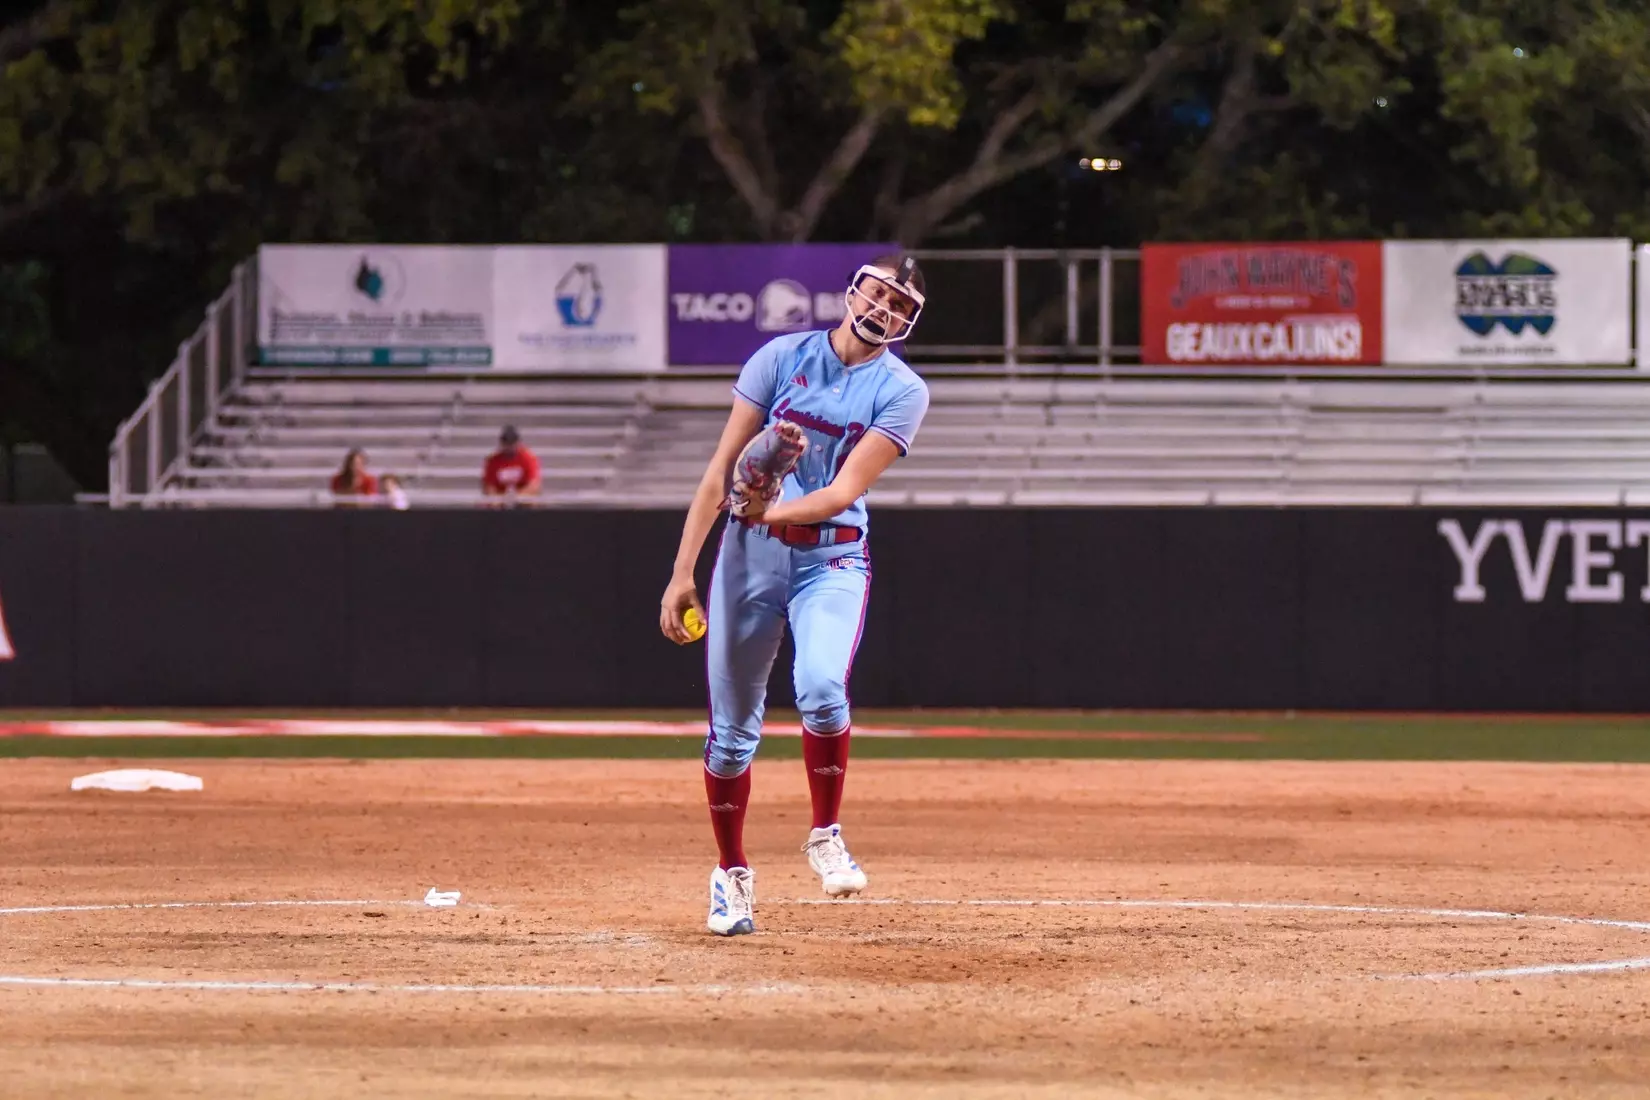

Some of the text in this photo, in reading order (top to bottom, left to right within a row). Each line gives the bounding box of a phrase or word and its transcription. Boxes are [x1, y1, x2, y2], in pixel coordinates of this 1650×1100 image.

[673, 291, 846, 321] TACO BE
[1166, 321, 1255, 361] GEAUX
